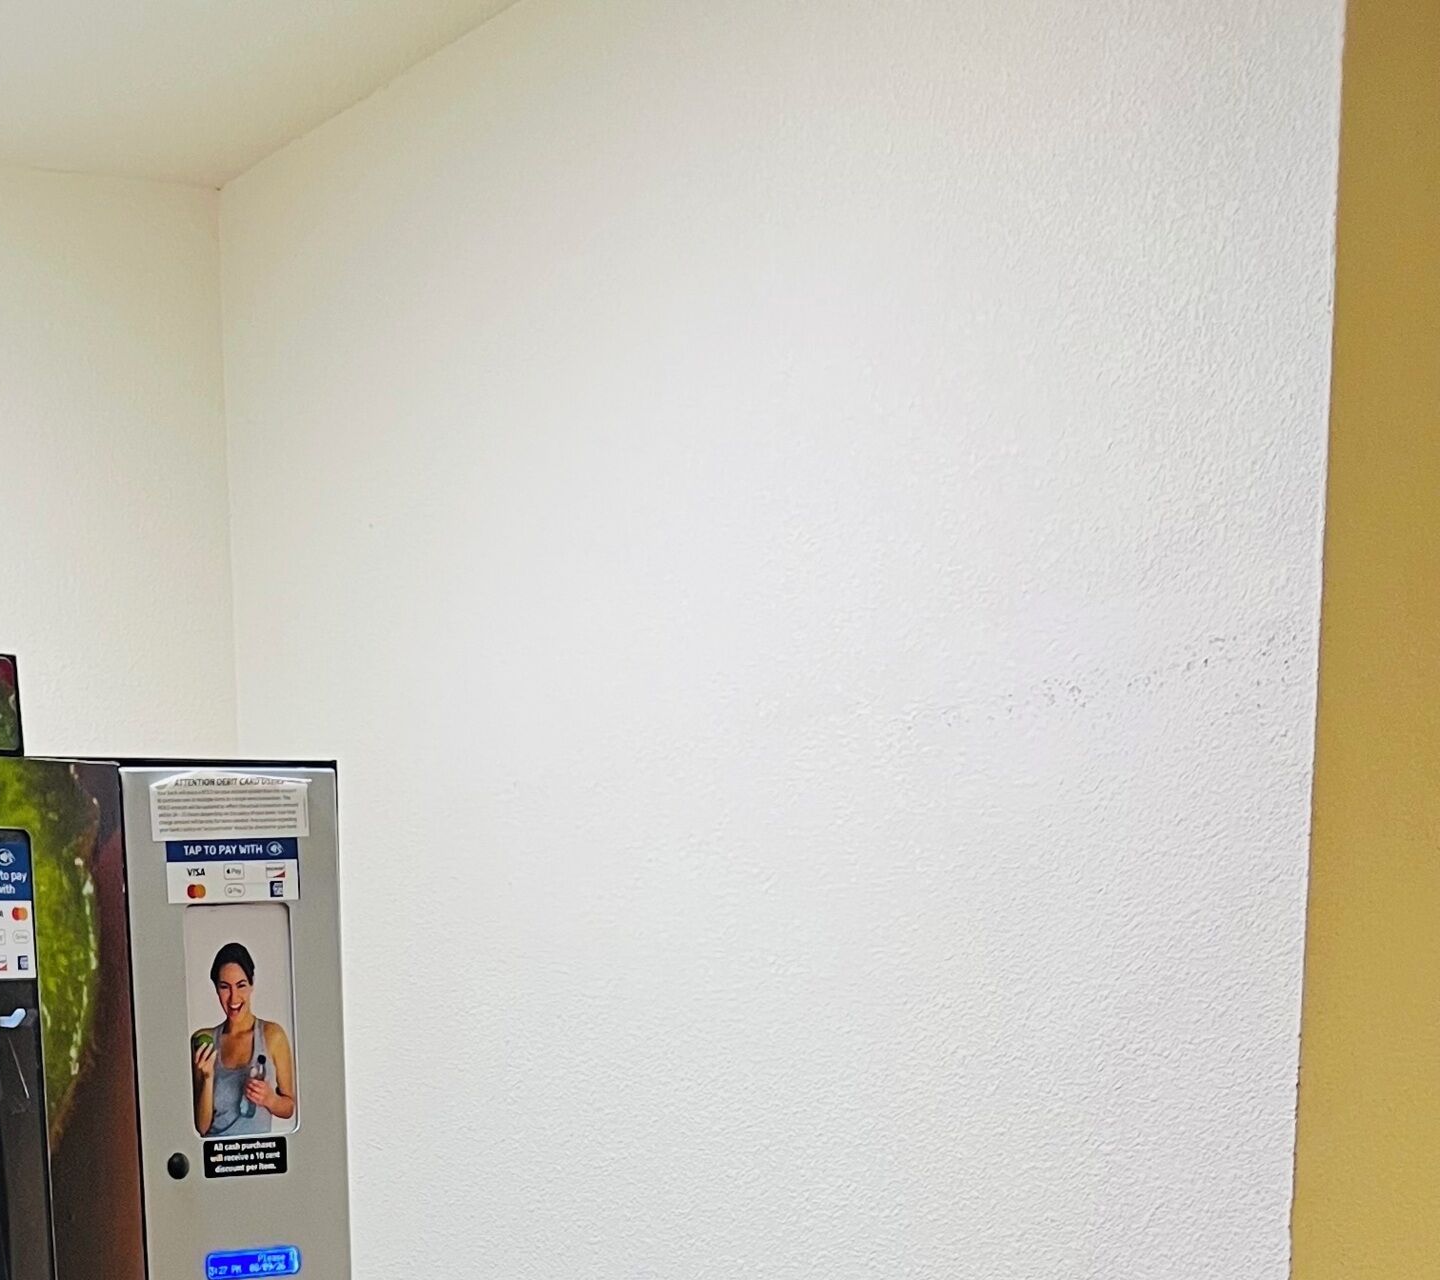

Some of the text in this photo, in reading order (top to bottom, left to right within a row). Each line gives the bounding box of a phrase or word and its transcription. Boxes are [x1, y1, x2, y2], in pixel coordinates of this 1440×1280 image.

[183, 844, 263, 856] TAP TO PAY WITH
[0, 870, 10, 881] to
[11, 871, 28, 883] pay
[186, 868, 206, 877] VISA
[225, 1142, 240, 1151] cash
[241, 1140, 276, 1152] purchases
[224, 1153, 249, 1162] receive
[215, 1163, 245, 1173] discount
[246, 1164, 258, 1173] per
